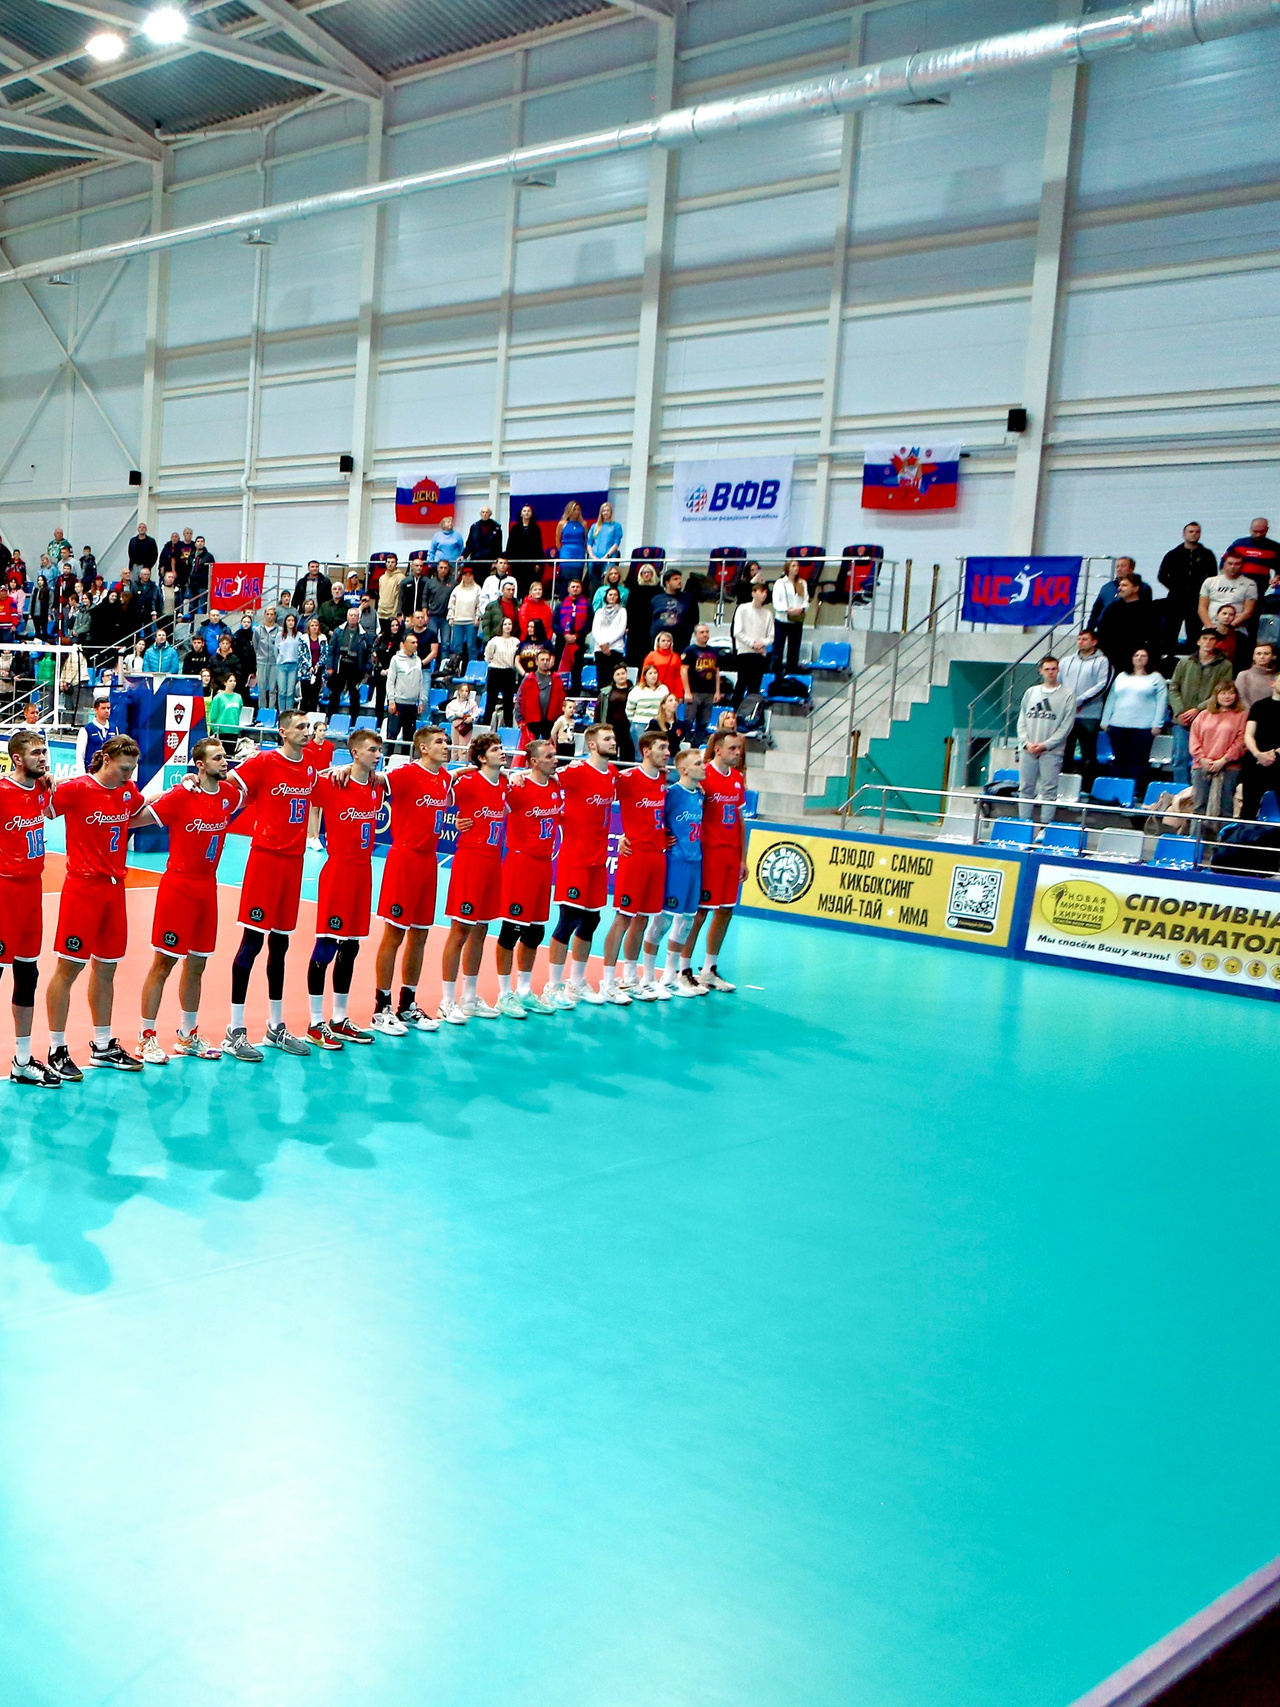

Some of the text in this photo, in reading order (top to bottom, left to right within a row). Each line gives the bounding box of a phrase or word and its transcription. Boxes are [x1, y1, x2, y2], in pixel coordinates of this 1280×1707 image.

[412, 490, 439, 504] ЦСКА
[708, 479, 781, 512] ВФВ
[1027, 711, 1057, 721] adidas
[289, 798, 307, 824] 13
[722, 804, 737, 825] 15
[110, 826, 121, 853] 2
[361, 822, 372, 850] 9
[486, 821, 503, 846] 17
[539, 817, 554, 840] 12
[26, 828, 45, 860] 18
[205, 835, 219, 863] 4
[829, 846, 934, 877] ДЗЮДО САМБО
[839, 872, 915, 899] КИКБОКСИНГ
[817, 893, 928, 928] МУАЙ-ТАЙ ММА
[1060, 901, 1105, 913] МИРОВАЯ
[1068, 894, 1107, 905] НОВАЯ
[1058, 909, 1104, 923] ХИРУРГИЯ
[1037, 934, 1170, 961] Мы спасём Вашу жизнь!
